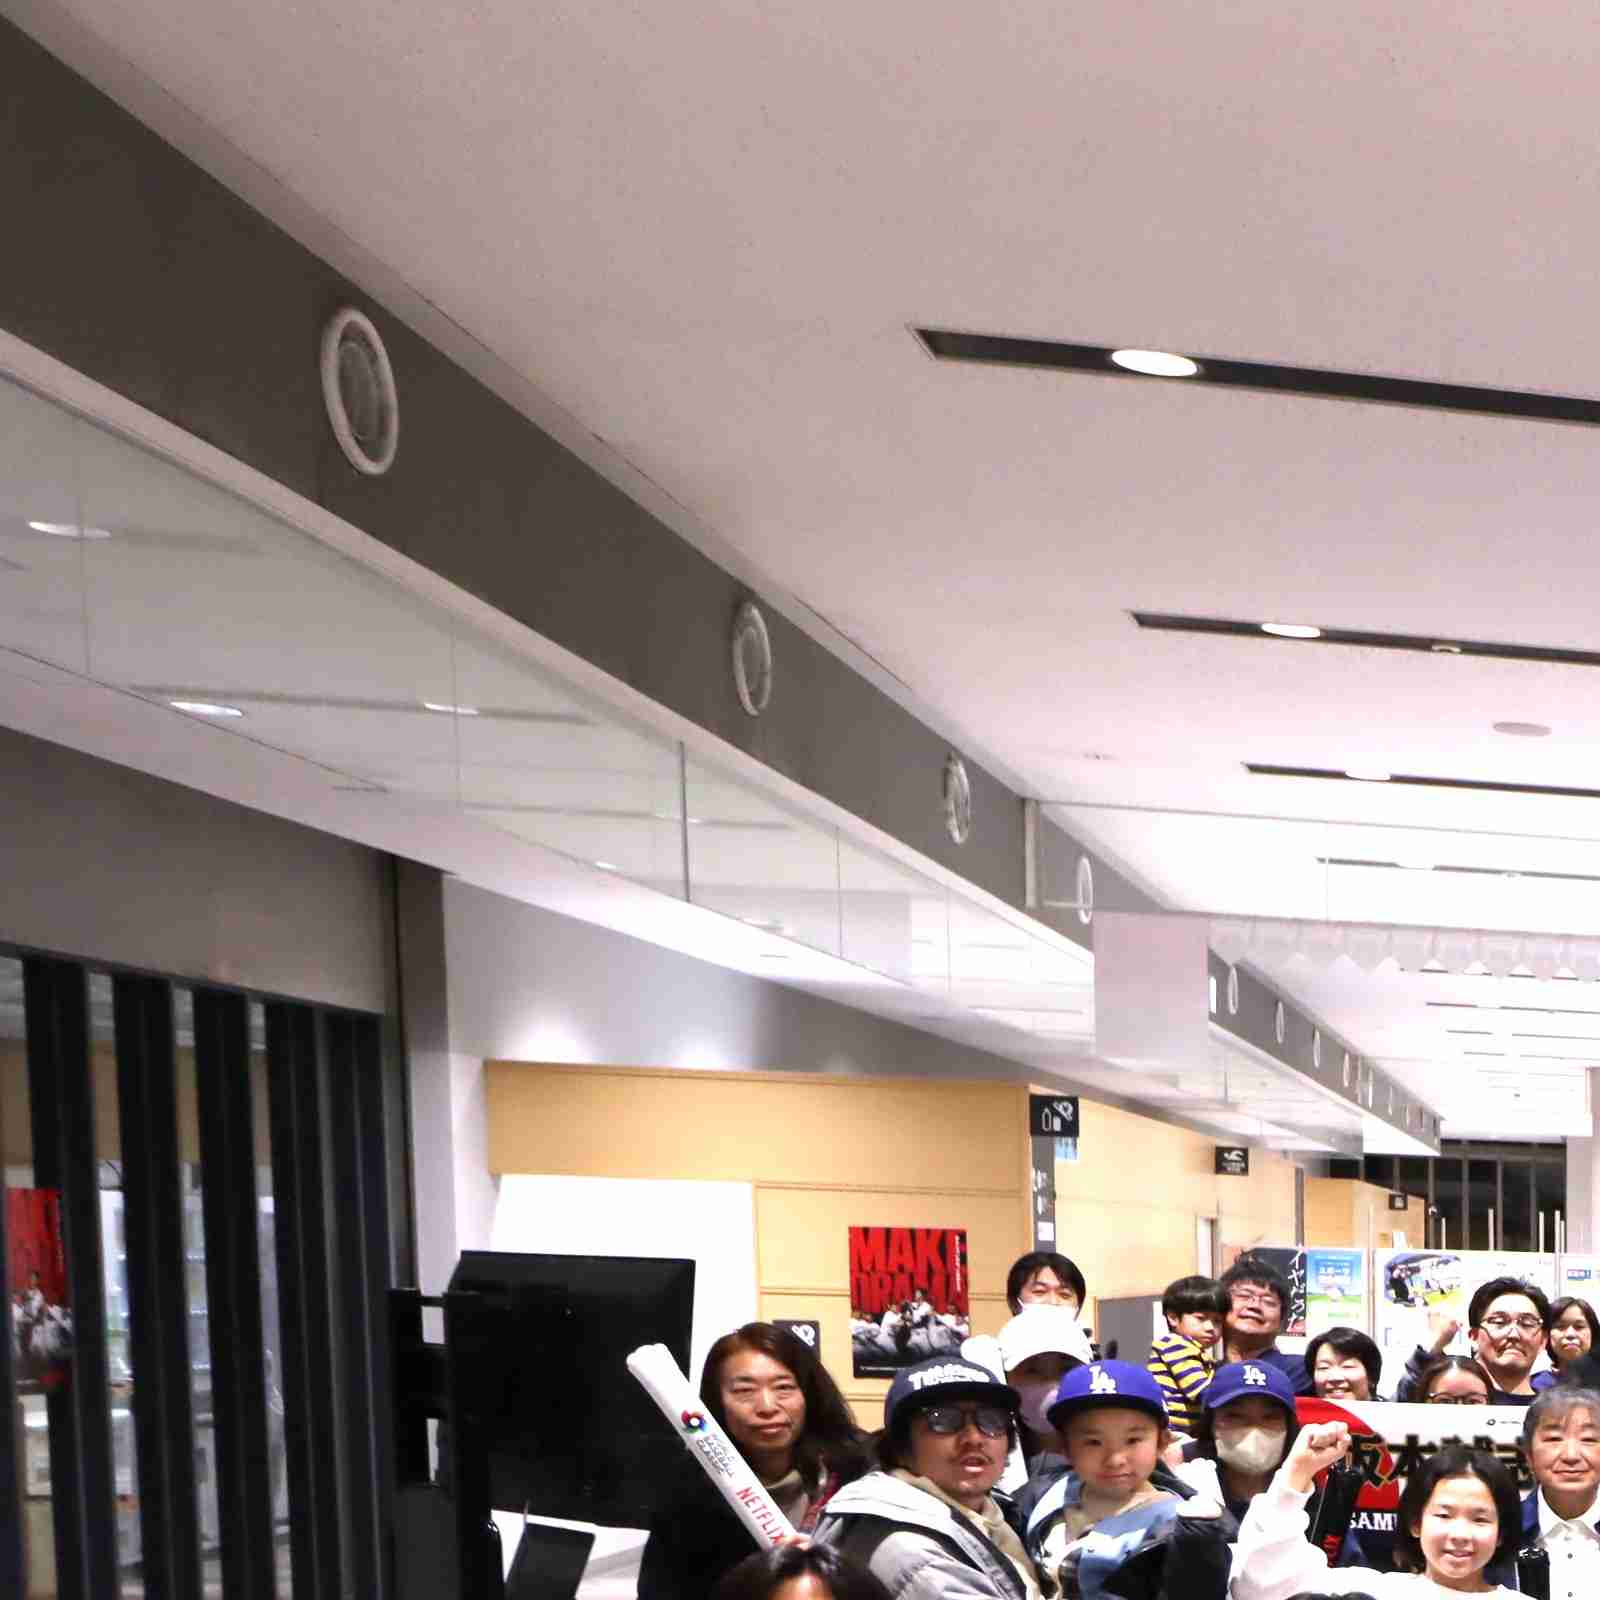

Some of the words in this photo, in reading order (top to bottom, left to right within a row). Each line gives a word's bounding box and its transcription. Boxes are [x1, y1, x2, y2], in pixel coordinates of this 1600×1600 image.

[1088, 1365, 1117, 1394] LA
[1242, 1365, 1267, 1386] LA
[736, 1487, 786, 1544] NETFLIX
